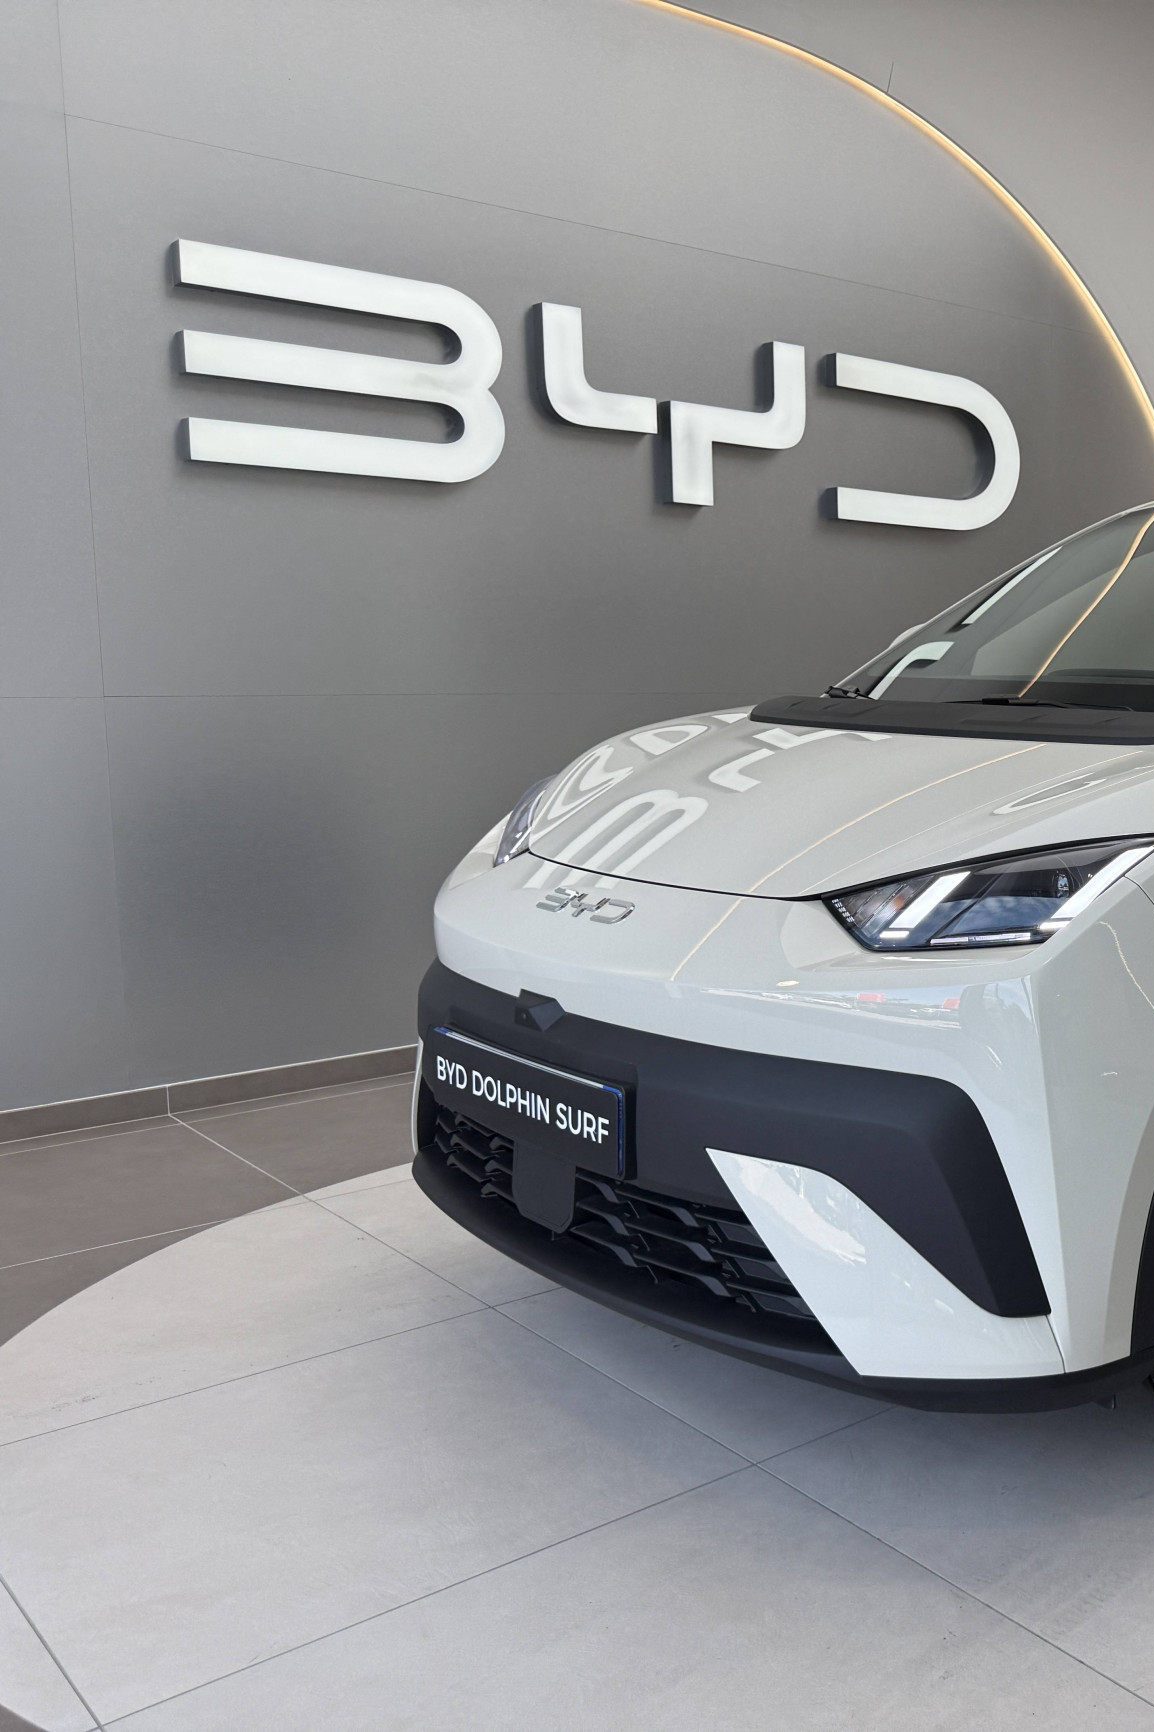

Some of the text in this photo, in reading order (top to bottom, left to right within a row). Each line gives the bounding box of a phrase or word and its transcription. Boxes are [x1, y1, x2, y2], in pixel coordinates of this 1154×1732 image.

[174, 238, 1021, 532] BYD
[536, 886, 636, 925] BYD
[436, 1055, 610, 1144] BYD DOLPHIN SURF
